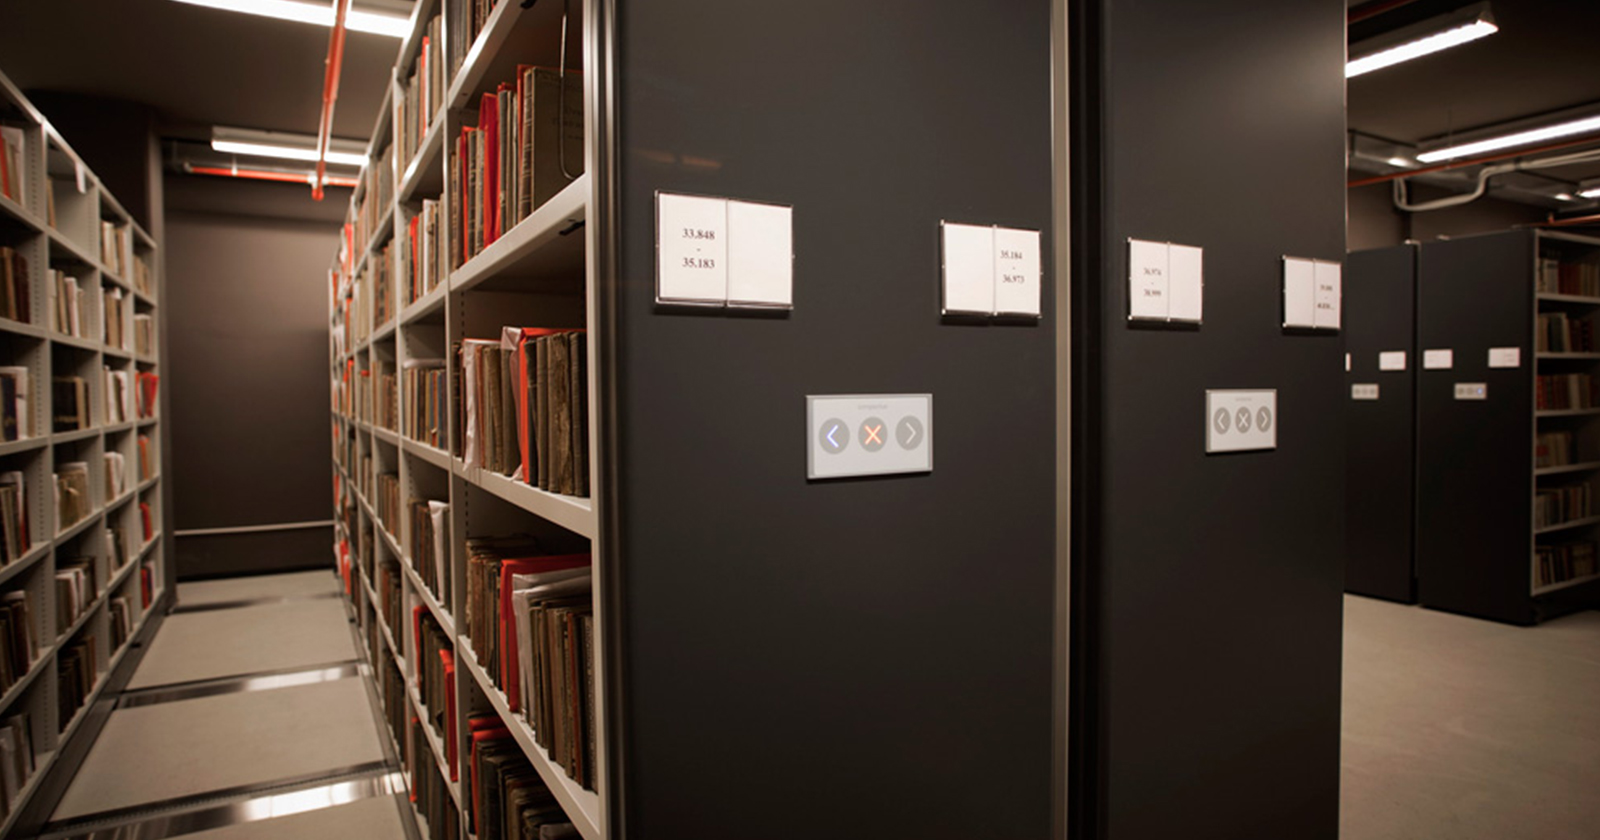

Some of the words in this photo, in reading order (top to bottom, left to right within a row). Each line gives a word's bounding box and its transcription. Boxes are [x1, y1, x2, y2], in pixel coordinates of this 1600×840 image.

[682, 228, 716, 240] 33.848
[1000, 250, 1023, 260] 35.184
[682, 257, 716, 269] 35.183
